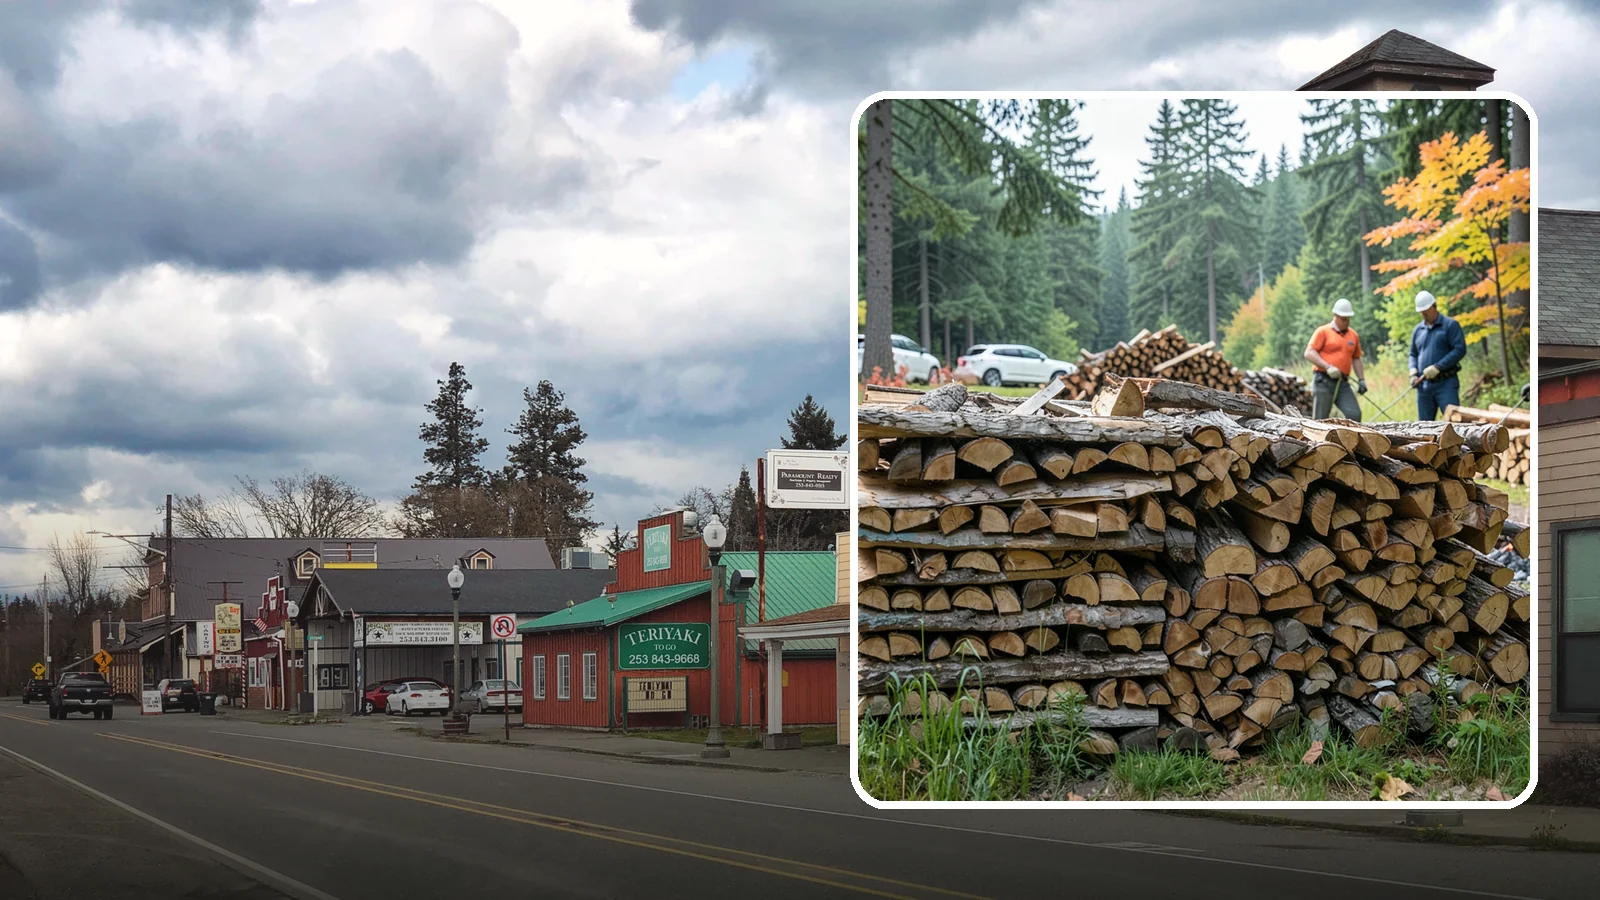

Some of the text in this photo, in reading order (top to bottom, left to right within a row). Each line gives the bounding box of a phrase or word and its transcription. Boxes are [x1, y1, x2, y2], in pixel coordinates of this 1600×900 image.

[625, 628, 702, 646] TERIYAKI
[629, 654, 700, 664] 253 843-9668
